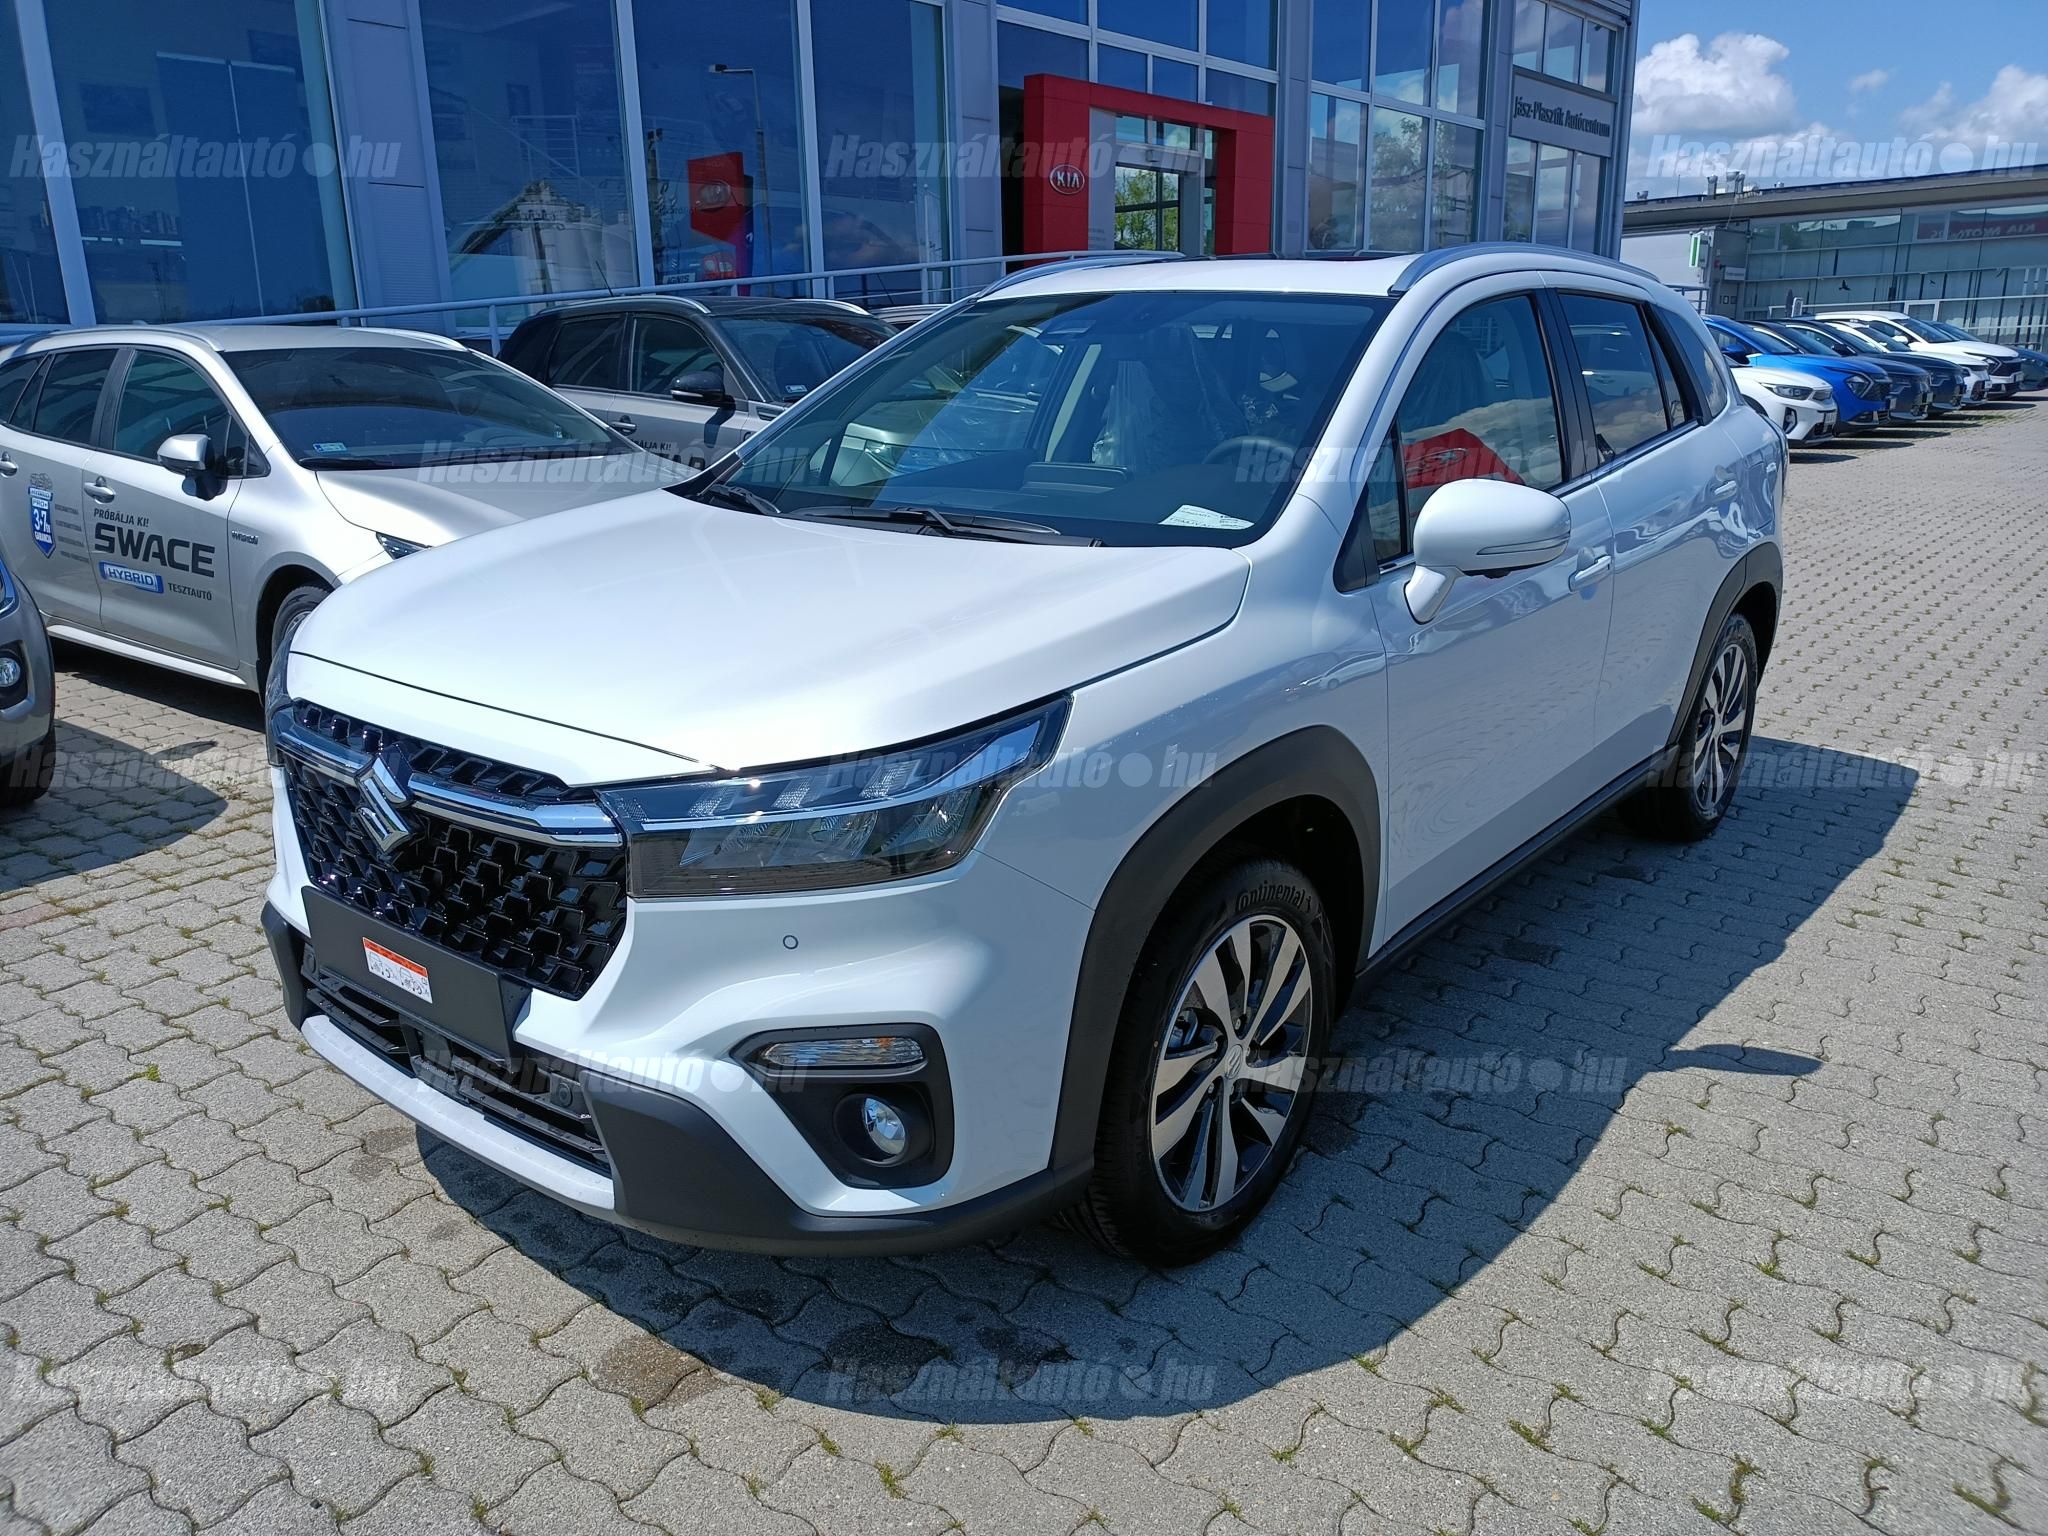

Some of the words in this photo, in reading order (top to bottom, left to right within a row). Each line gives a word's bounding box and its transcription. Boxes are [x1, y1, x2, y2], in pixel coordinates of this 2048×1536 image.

[1056, 171, 1080, 188] KIA
[137, 516, 149, 528] KI!
[94, 522, 216, 578] SWACE
[108, 567, 154, 586] HYBRID
[168, 582, 212, 601] TESZTAUTÓ
[1235, 880, 1306, 914] Continental
